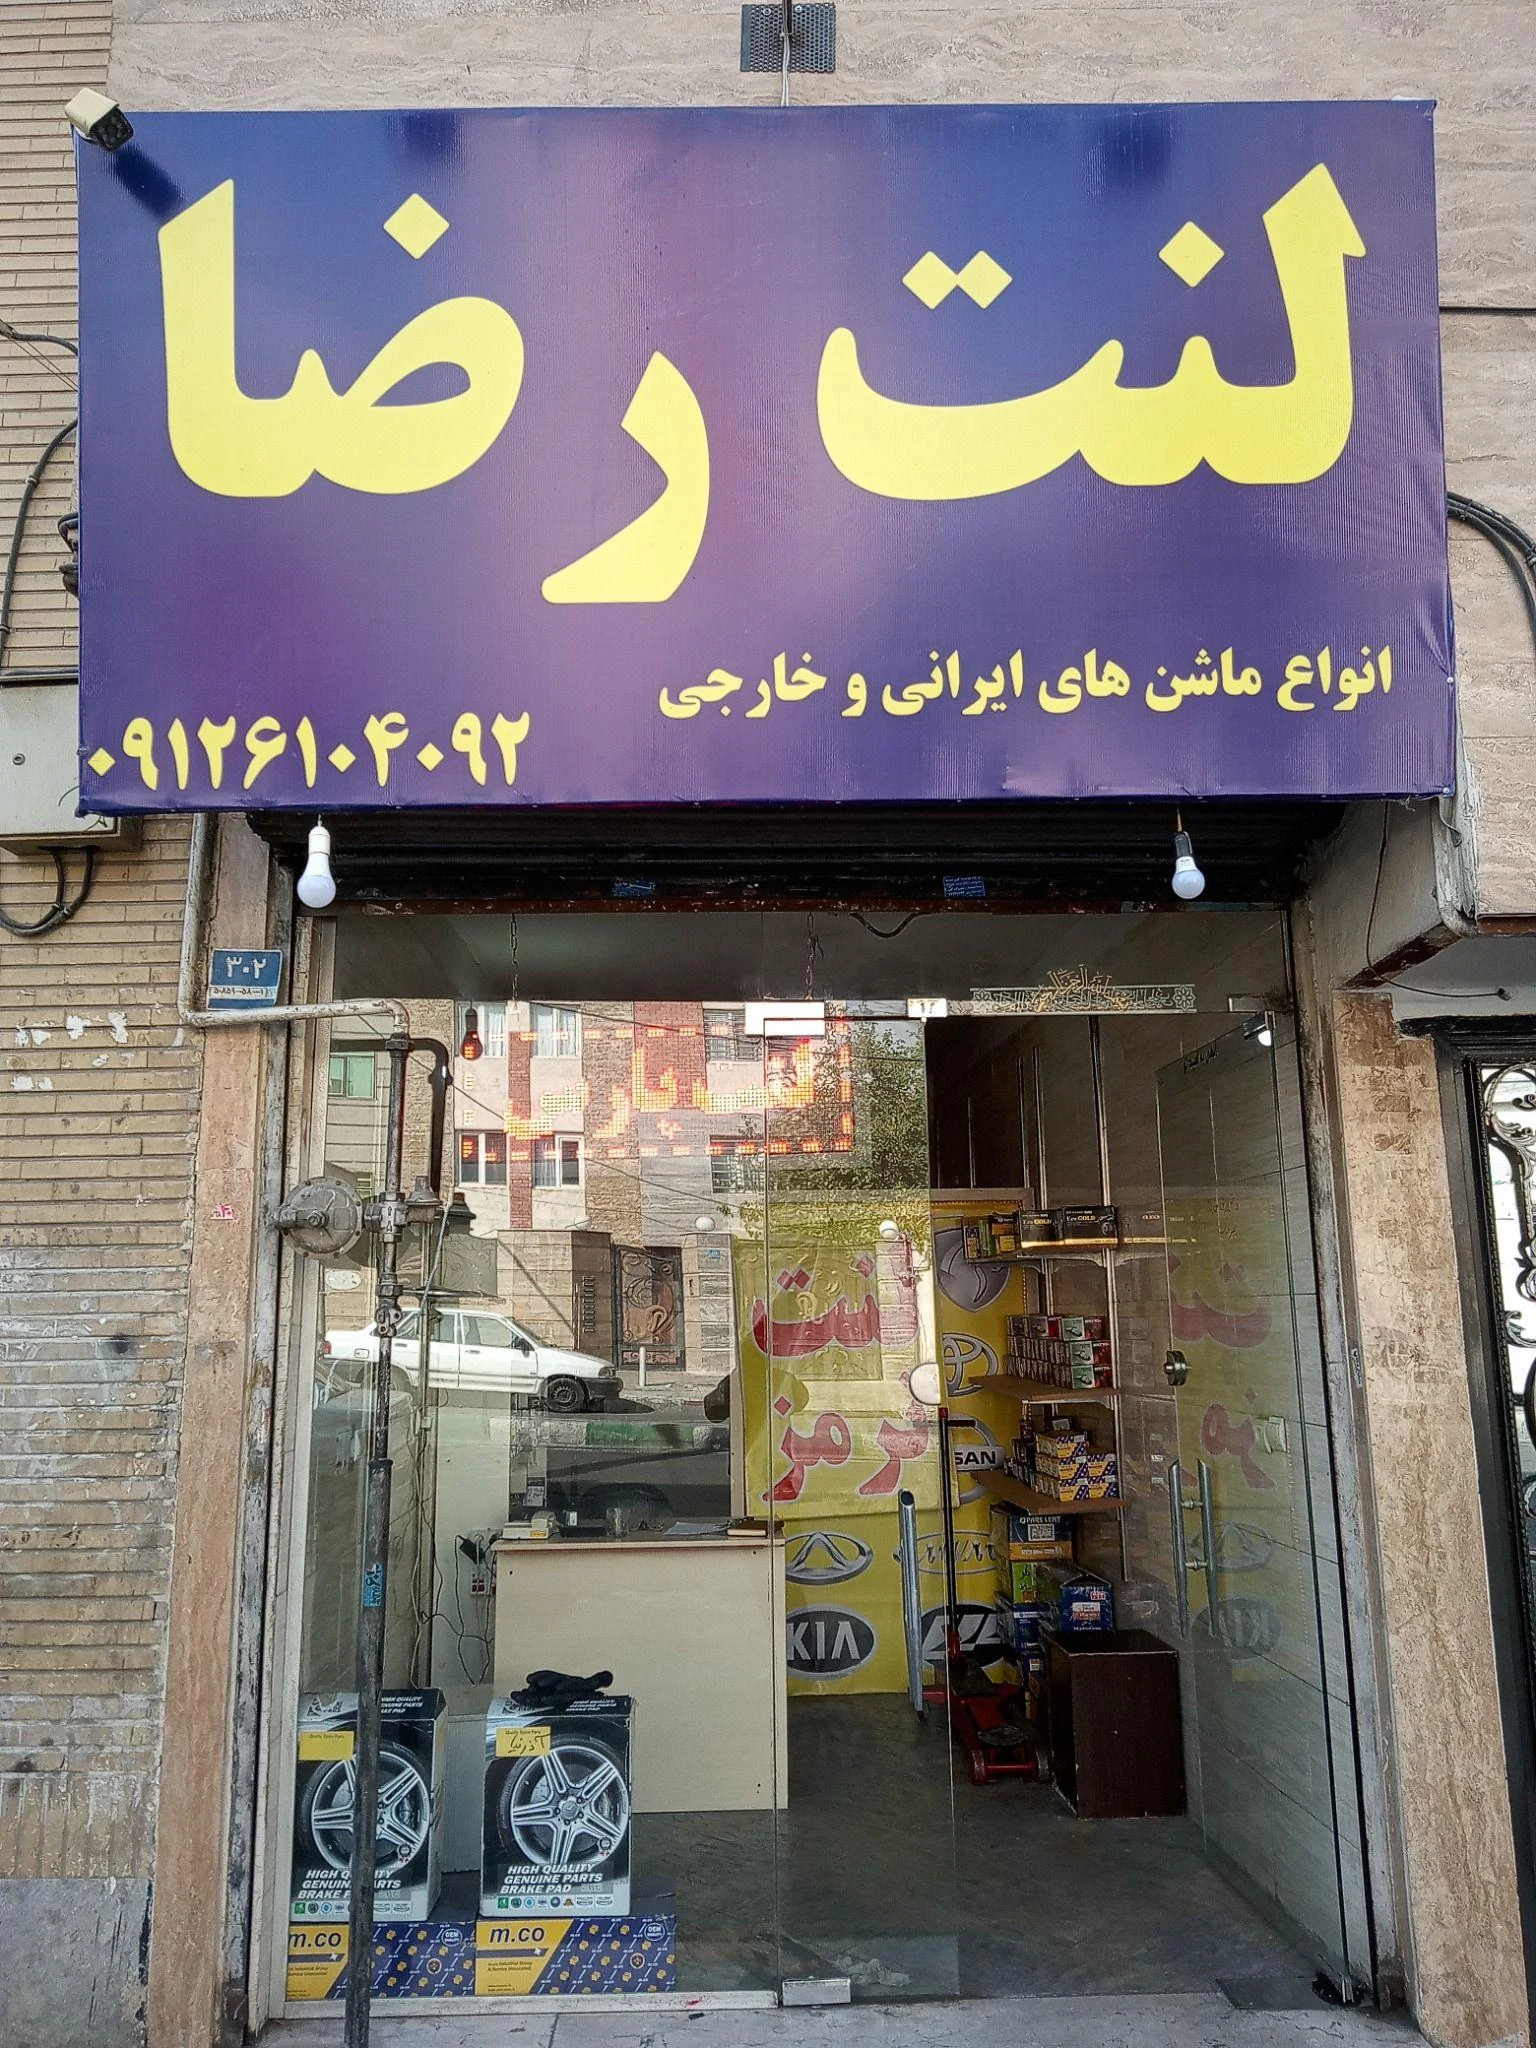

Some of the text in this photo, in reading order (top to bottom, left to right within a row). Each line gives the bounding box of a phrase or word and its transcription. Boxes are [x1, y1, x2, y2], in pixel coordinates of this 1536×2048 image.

[159, 163, 1367, 604] لنت رضا
[659, 646, 1393, 719] انواع ماشن های ایرانی و خارجی
[88, 711, 531, 790] ۰۹۱۲۶۱۰۴۰۹۲
[225, 956, 267, 979] ۳۰۲
[955, 1451, 997, 1466] SAN
[786, 1621, 861, 1660] KIA
[305, 1869, 338, 1879] HIGH
[507, 1863, 597, 1875] HIGH QUALITY
[302, 1880, 352, 1889] GENUIN
[503, 1873, 604, 1884] GENUINE PARTS
[297, 1889, 341, 1899] BRAKE
[500, 1885, 545, 1894] BRAKE
[545, 1884, 572, 1894] PAD
[288, 1931, 342, 1948] m.co
[489, 1926, 546, 1943] m.co
